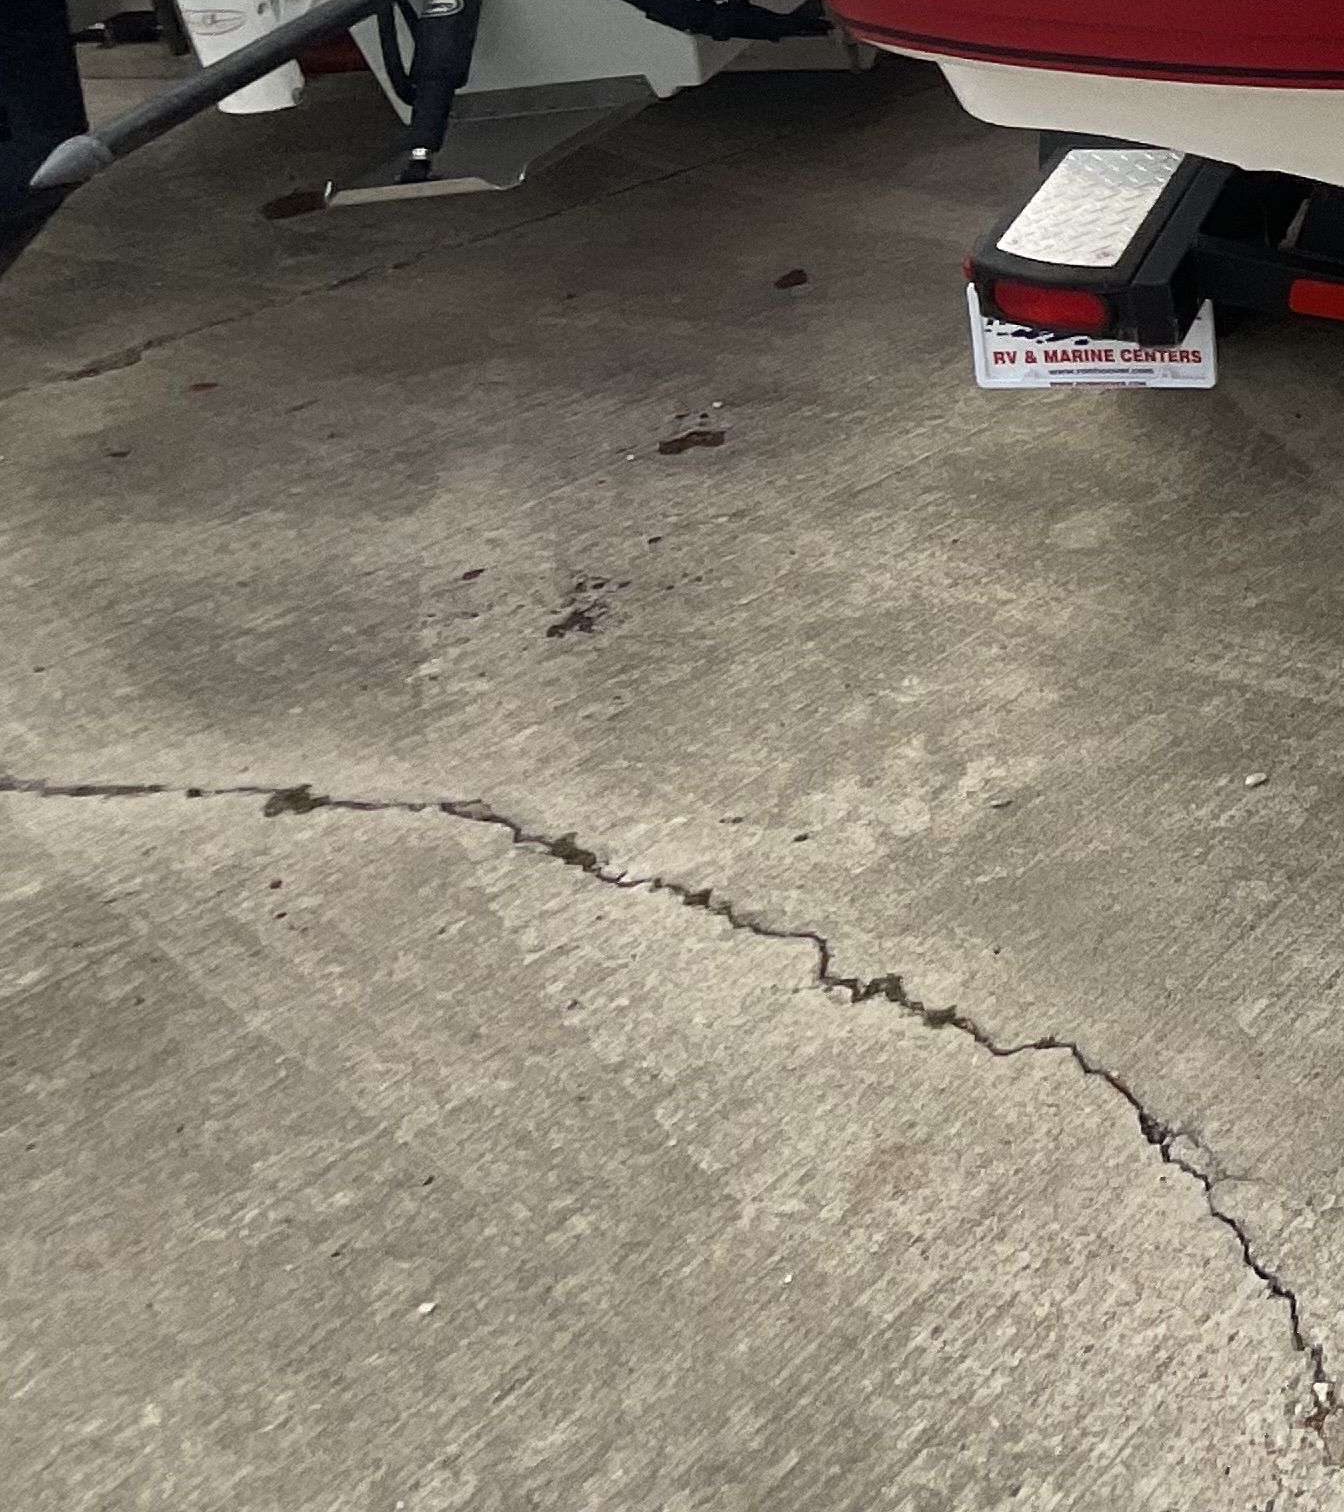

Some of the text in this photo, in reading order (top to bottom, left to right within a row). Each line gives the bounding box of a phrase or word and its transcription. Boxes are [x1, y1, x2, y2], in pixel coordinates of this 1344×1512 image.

[993, 349, 1203, 366] RV & MARINE CENTERS
